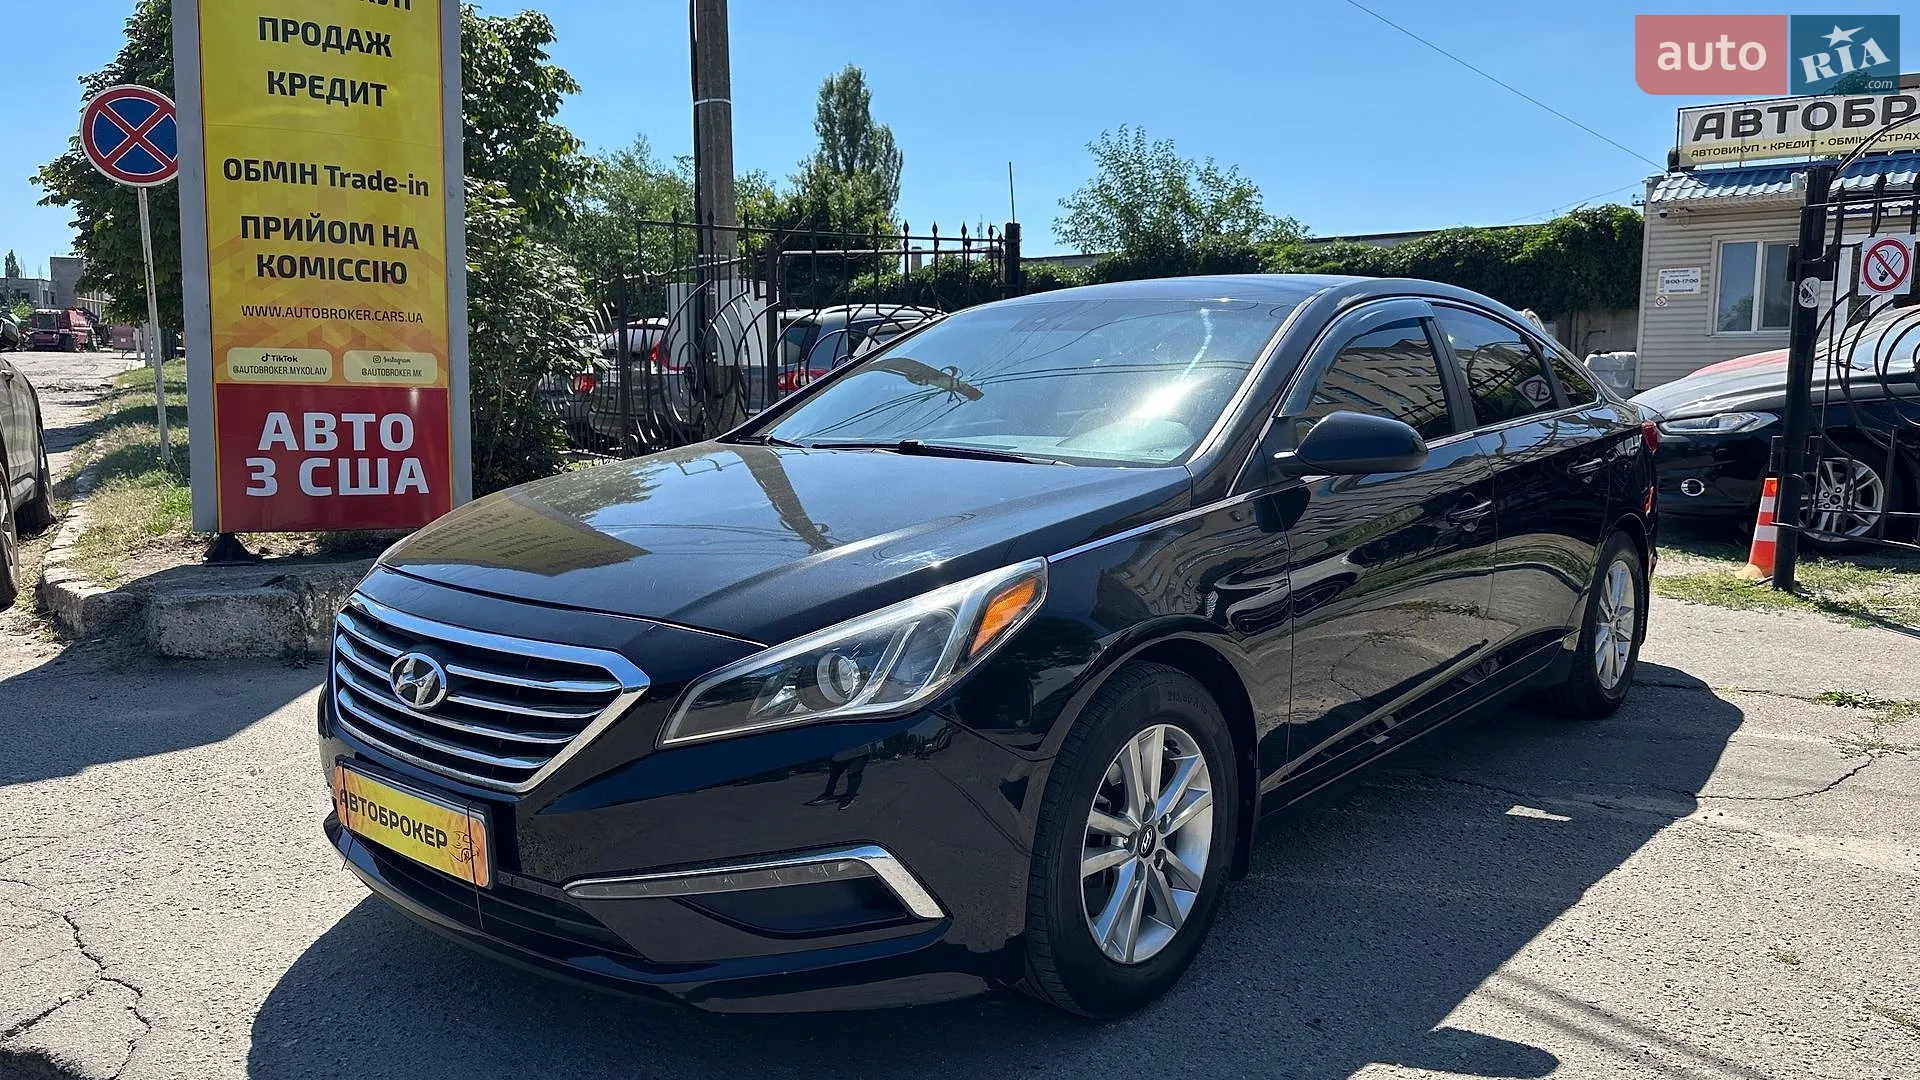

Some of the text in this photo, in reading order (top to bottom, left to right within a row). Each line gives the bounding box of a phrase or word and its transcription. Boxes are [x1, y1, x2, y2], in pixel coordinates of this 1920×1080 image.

[258, 16, 393, 58] ПРОДАЖ
[267, 70, 388, 107] КРЕДИТ
[1692, 95, 1917, 142] АВТОБР
[1690, 144, 1760, 158] АВТОВИКУП
[1770, 139, 1818, 151] КРЕДИТ
[1827, 135, 1867, 147] ОБМІН
[223, 158, 430, 197] ОБМІН Trade-in
[240, 212, 420, 250] ПРИЙОМ НА
[256, 253, 408, 285] КОМІССІЮ
[241, 305, 423, 324] WWW.AUTOBROKER.CARS.UA
[232, 365, 327, 376] @AUTOBROKER.MYKOLAIV
[270, 354, 298, 363] TikTok
[361, 367, 423, 378] @AUTOBROKER.MK
[382, 355, 411, 365] Instagram
[257, 411, 415, 452] АВТО
[299, 457, 430, 497] США
[339, 789, 448, 850] АВТОБРОКЕР
